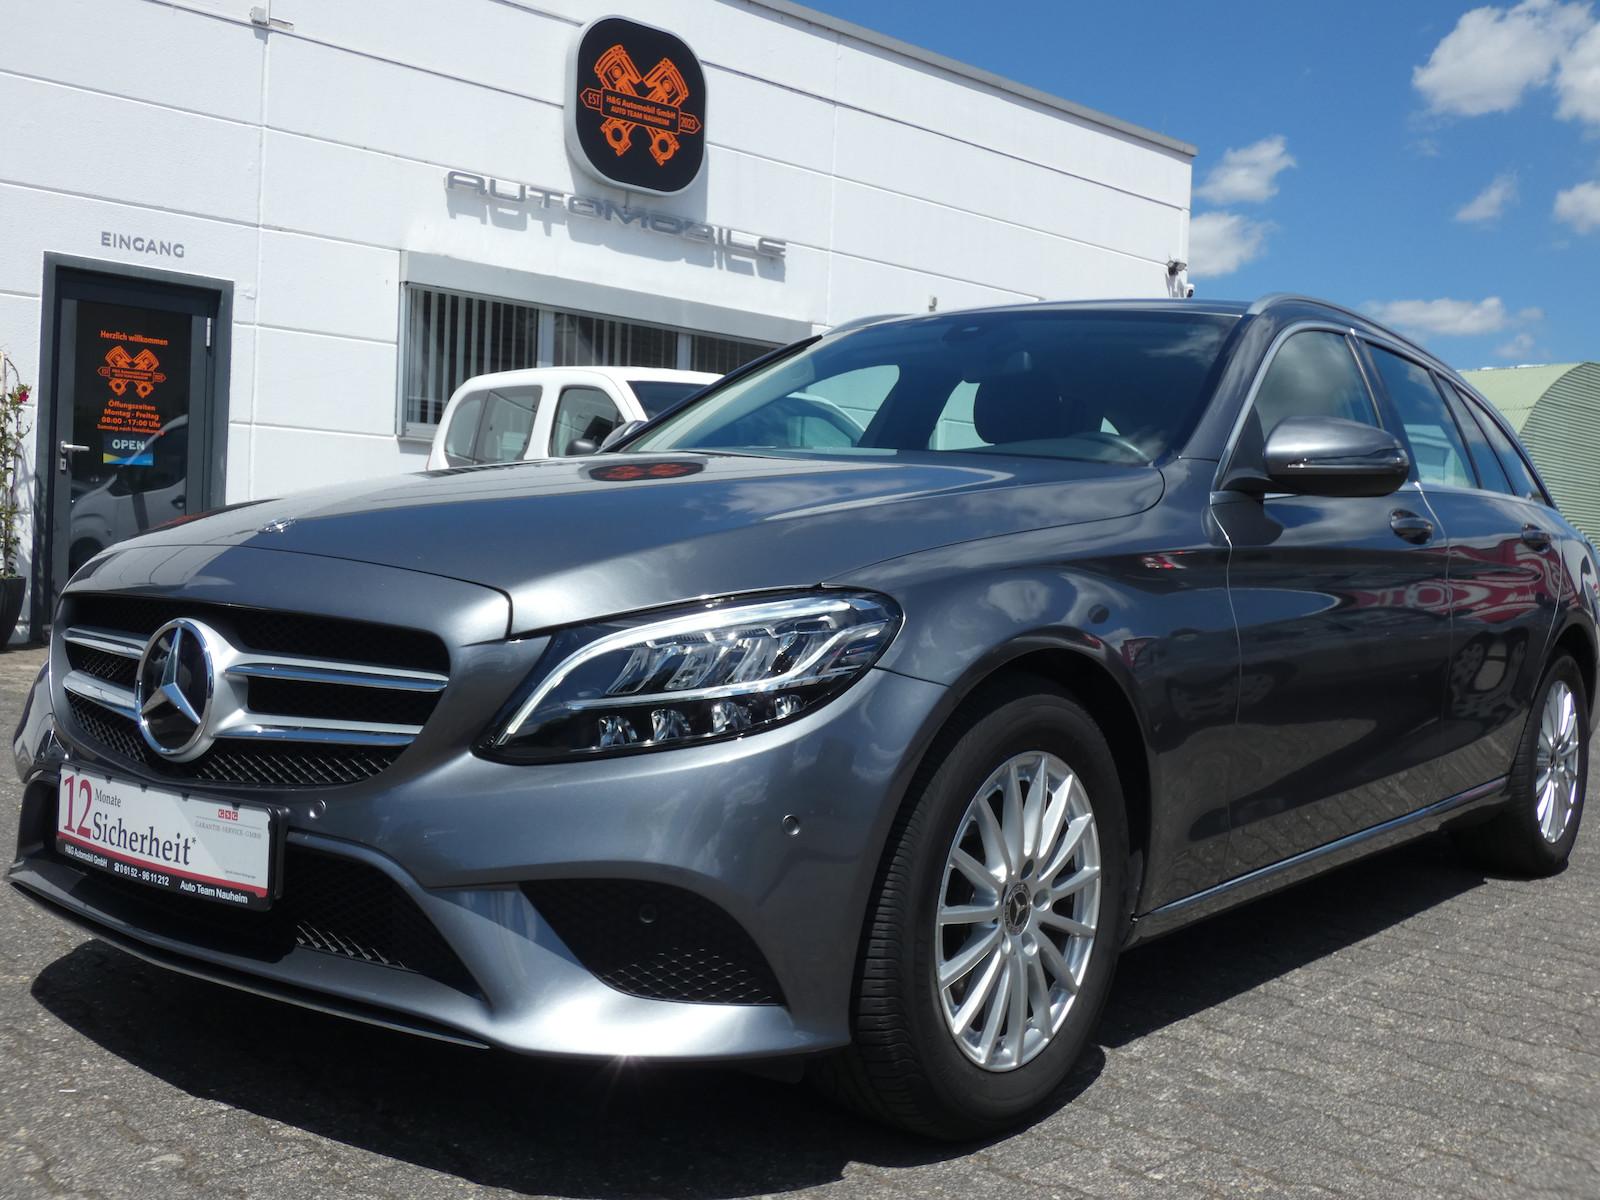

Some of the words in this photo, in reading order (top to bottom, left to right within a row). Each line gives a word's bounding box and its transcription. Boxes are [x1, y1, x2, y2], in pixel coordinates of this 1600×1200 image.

[588, 93, 600, 105] EST
[606, 95, 622, 106] H&G
[622, 100, 656, 114] Automobil
[656, 108, 676, 119] GmbH
[611, 106, 626, 115] AUTO
[627, 109, 643, 119] TEAM
[643, 113, 670, 126] NAUHEIM
[446, 170, 786, 259] AUTOMOBILE
[101, 231, 185, 258] EINGANG
[100, 330, 128, 341] Herzlich
[128, 334, 168, 346] willkommen
[104, 408, 131, 418] Montag
[135, 411, 160, 421] Freitag
[112, 439, 145, 450] OPEN
[64, 774, 93, 840] 12
[95, 788, 122, 808] Monate
[74, 848, 94, 863] Automobil
[94, 855, 108, 868] GmbH
[180, 880, 196, 893] Auto
[197, 884, 215, 897] Team
[216, 888, 248, 904] Nauheim
